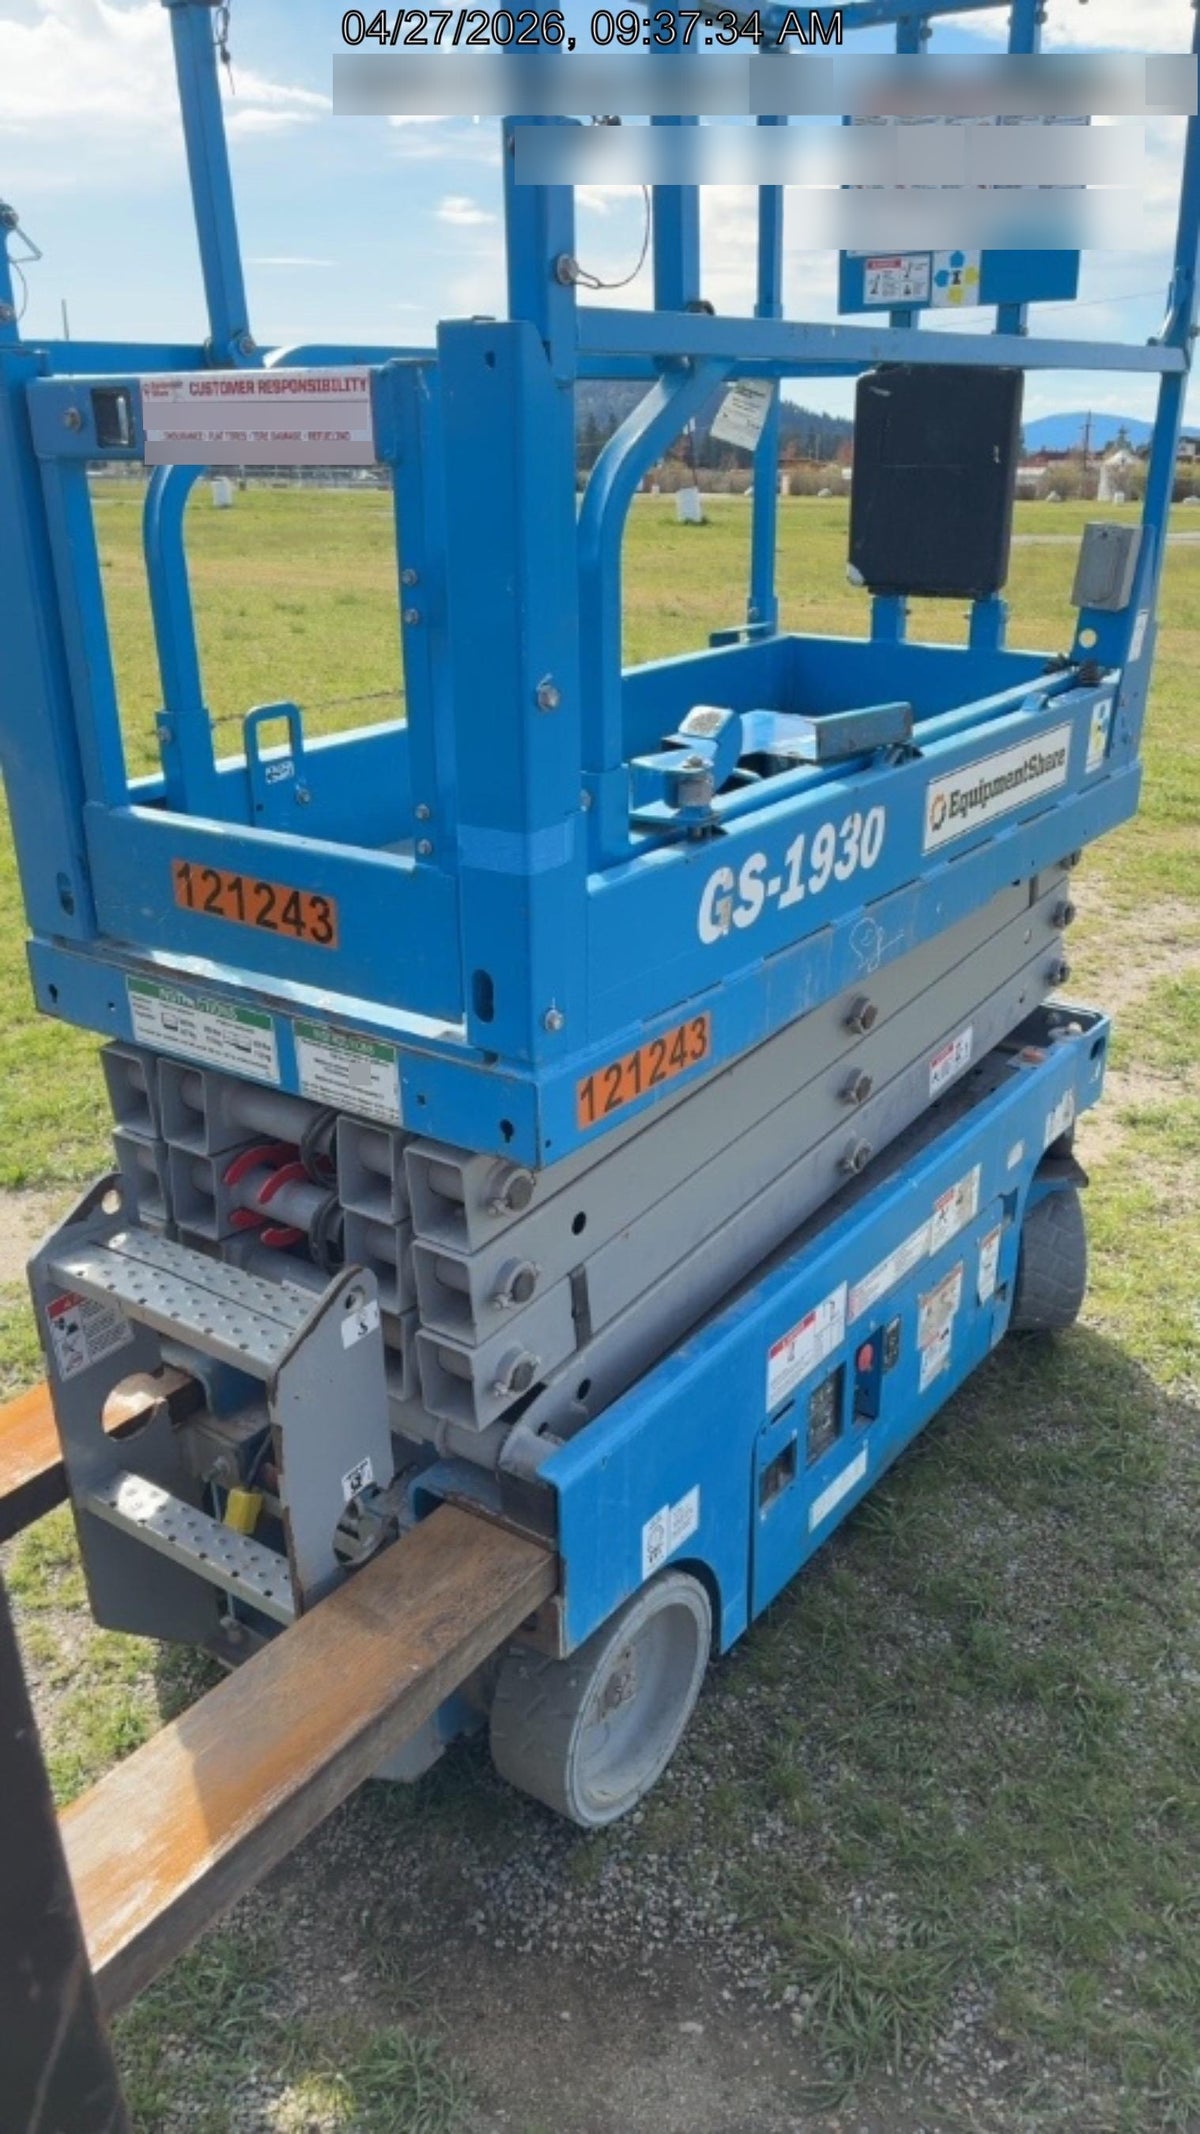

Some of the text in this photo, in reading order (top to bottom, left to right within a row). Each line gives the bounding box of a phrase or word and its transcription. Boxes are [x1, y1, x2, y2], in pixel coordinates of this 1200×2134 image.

[189, 379, 255, 397] CUSTOMER
[258, 376, 367, 395] RESPONSIBILITY
[948, 747, 1066, 819] EquipmentShare
[176, 862, 334, 945] 121243
[697, 805, 886, 945] GS-1930
[580, 1016, 708, 1123] 121243
